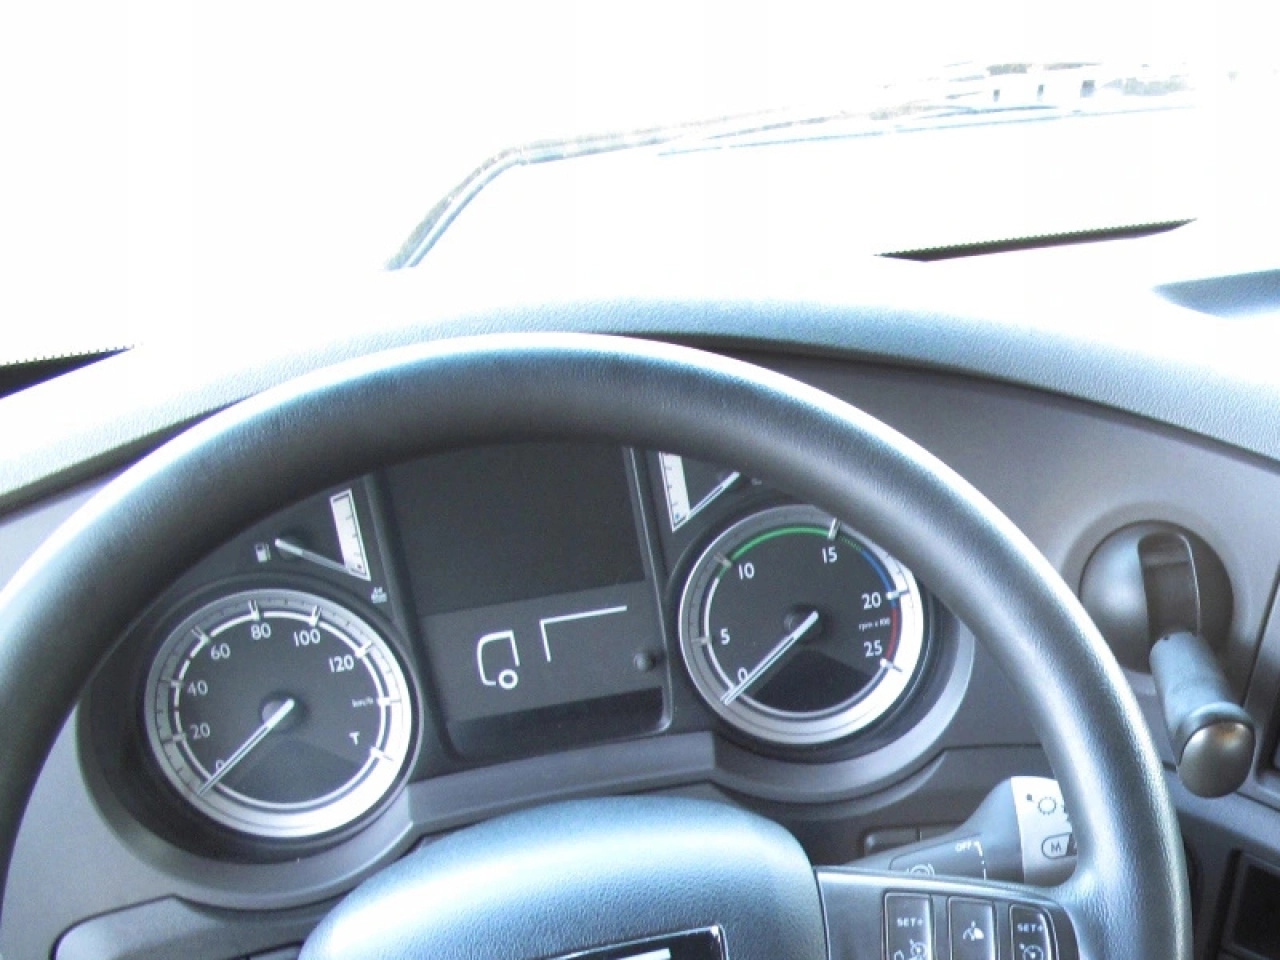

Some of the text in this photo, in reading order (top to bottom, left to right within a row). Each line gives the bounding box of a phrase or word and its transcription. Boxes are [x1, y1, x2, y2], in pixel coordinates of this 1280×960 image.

[822, 547, 838, 564] 15
[738, 563, 755, 580] 10
[861, 592, 882, 610] 20
[250, 623, 272, 641] 80
[293, 628, 321, 647] 100
[720, 629, 731, 645] 5
[210, 643, 231, 660] 60
[863, 639, 883, 657] 25
[328, 656, 355, 673] 120
[186, 680, 209, 697] 40
[192, 722, 211, 739] 20
